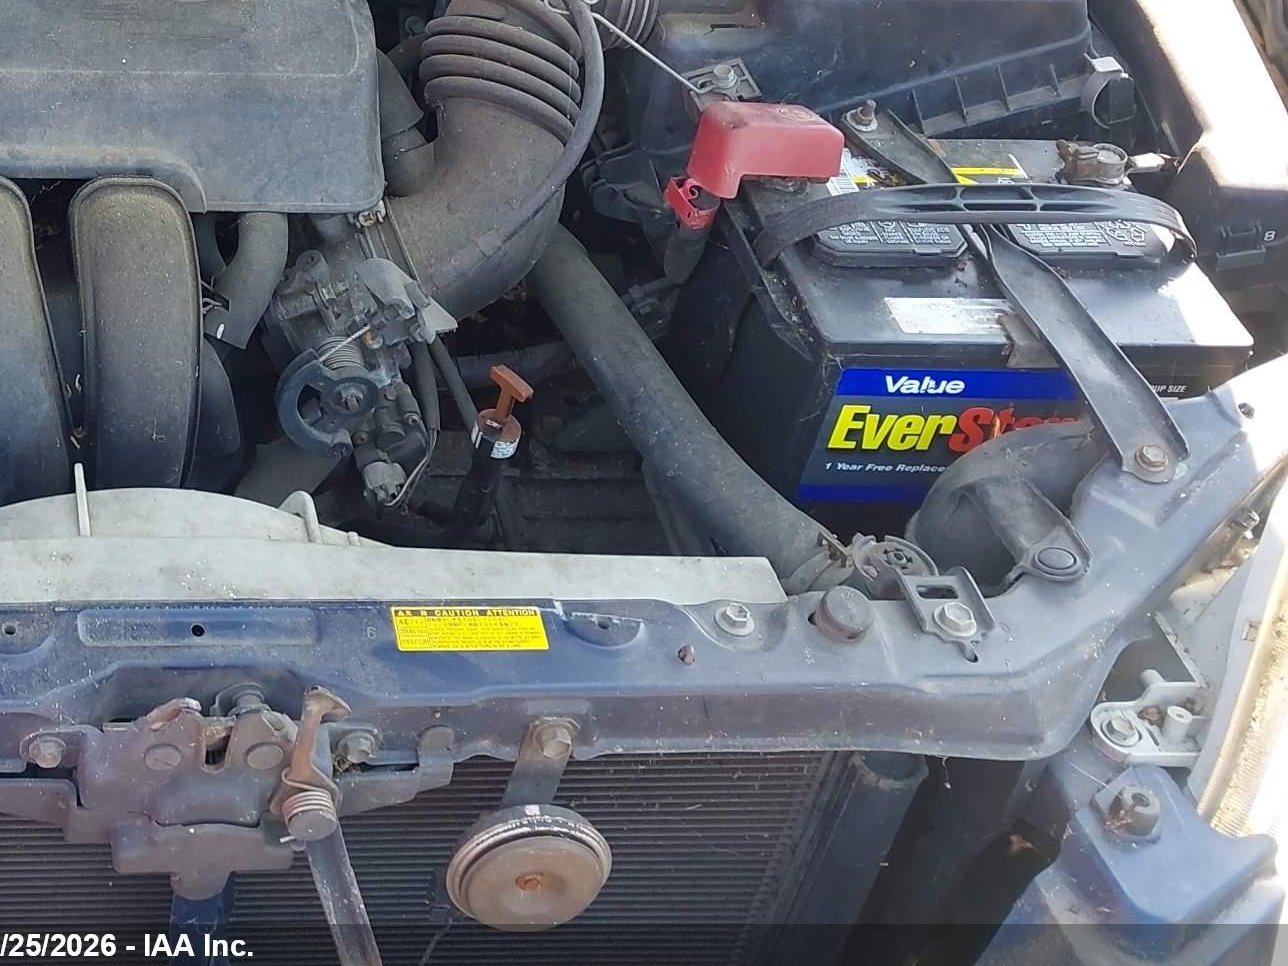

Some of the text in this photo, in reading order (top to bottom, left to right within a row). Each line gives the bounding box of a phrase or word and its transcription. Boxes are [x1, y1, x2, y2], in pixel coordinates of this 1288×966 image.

[885, 375, 966, 395] Value
[1167, 385, 1187, 393] SIZE
[824, 462, 950, 475] 1 Year Free Replace
[434, 609, 480, 617] CAUTION
[486, 609, 535, 617] ATTENTION
